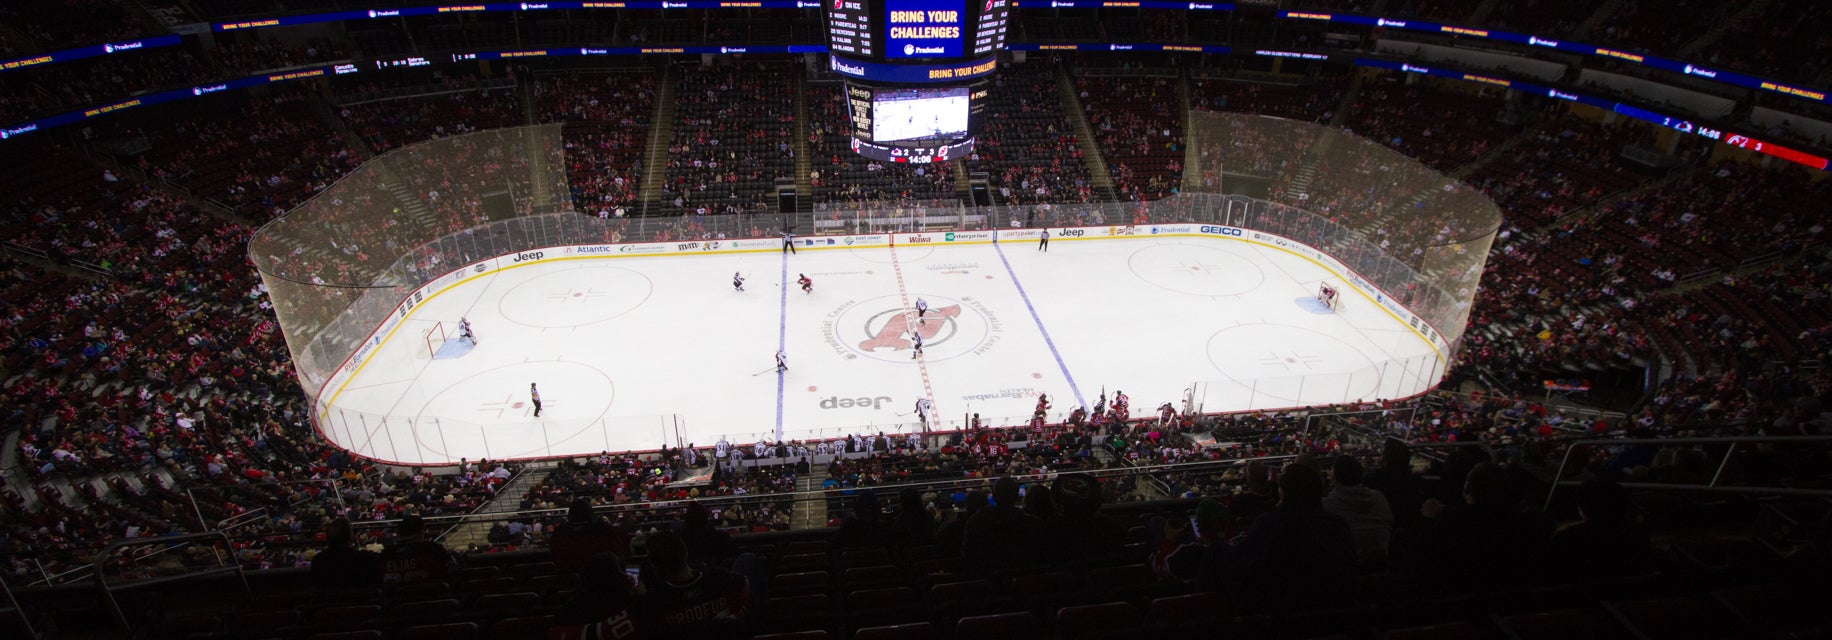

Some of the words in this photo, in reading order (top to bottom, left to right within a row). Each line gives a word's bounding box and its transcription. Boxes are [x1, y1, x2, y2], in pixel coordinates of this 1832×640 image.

[891, 11, 924, 23] BRING
[928, 11, 957, 23] YOUR
[891, 27, 960, 39] CHALLENGES
[114, 42, 142, 50] Prudential
[5, 61, 19, 70] YOUR
[20, 56, 53, 67] CHALLENGES
[837, 62, 865, 76] Prudential
[929, 69, 952, 79] BRING
[954, 66, 972, 77] YOUR
[848, 87, 871, 100] Jeep
[1663, 117, 1670, 126] 2
[856, 129, 871, 139] Jeep
[1697, 126, 1720, 140] 14:06
[930, 148, 934, 156] 3
[1754, 142, 1762, 152] 3
[908, 156, 931, 164] 14:06
[1059, 228, 1084, 237] Jeep
[1160, 226, 1191, 234] Prudential
[1200, 225, 1242, 237] GEICO
[909, 235, 931, 244] Wawa
[577, 245, 611, 254] Atlantic
[513, 250, 544, 263] Jeep
[828, 299, 856, 318] Center
[970, 300, 1003, 332] Prudential
[818, 319, 846, 356] Prudential
[974, 334, 1001, 357] Center
[820, 396, 892, 410] Jeep
[386, 558, 417, 574] ELIAS
